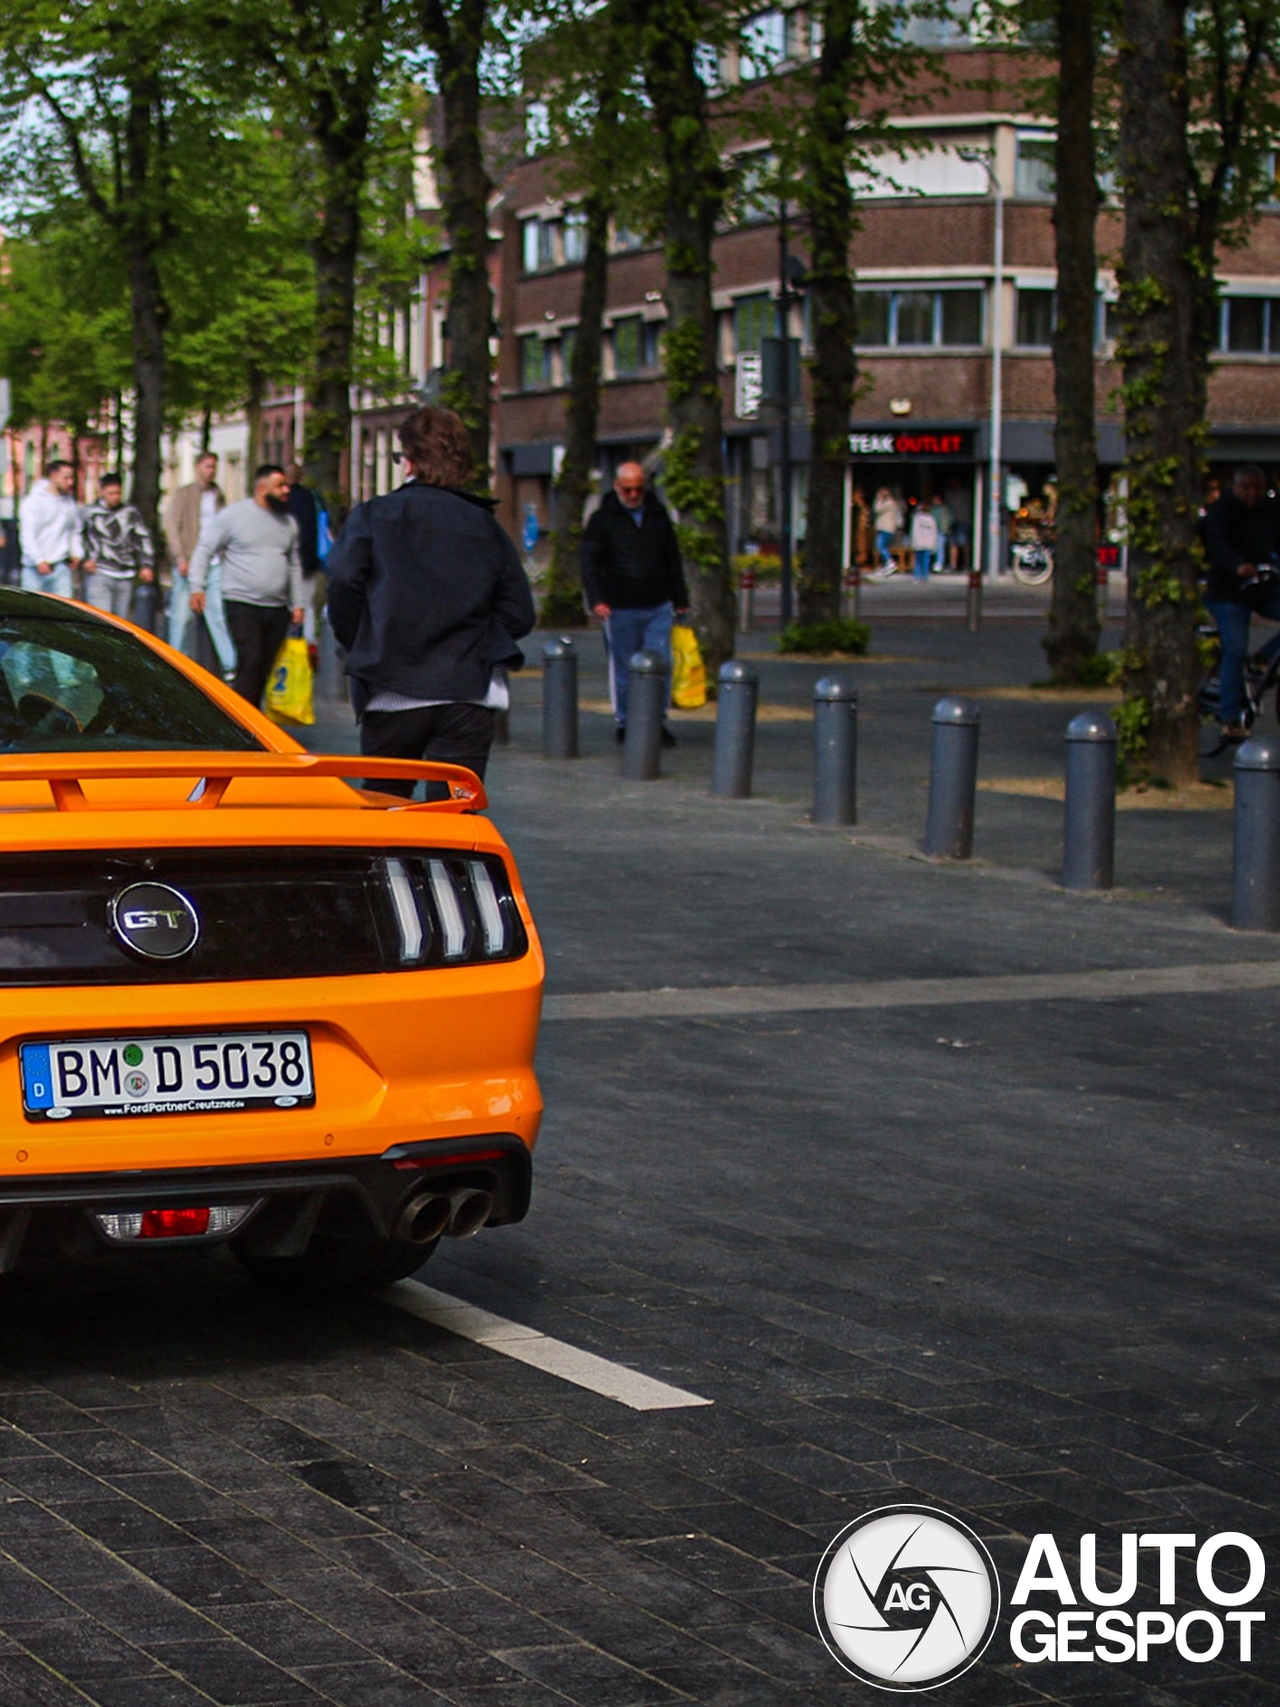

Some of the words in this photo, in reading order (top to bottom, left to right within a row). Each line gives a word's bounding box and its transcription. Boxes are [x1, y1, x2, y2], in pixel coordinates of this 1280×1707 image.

[896, 436, 961, 453] OUTLET
[123, 911, 187, 929] GT
[57, 1049, 121, 1098] BM
[153, 1046, 183, 1093] D
[193, 1041, 304, 1091] 5038
[34, 1083, 45, 1097] D
[104, 1100, 245, 1115] www.FordPartnerCreutzner.de
